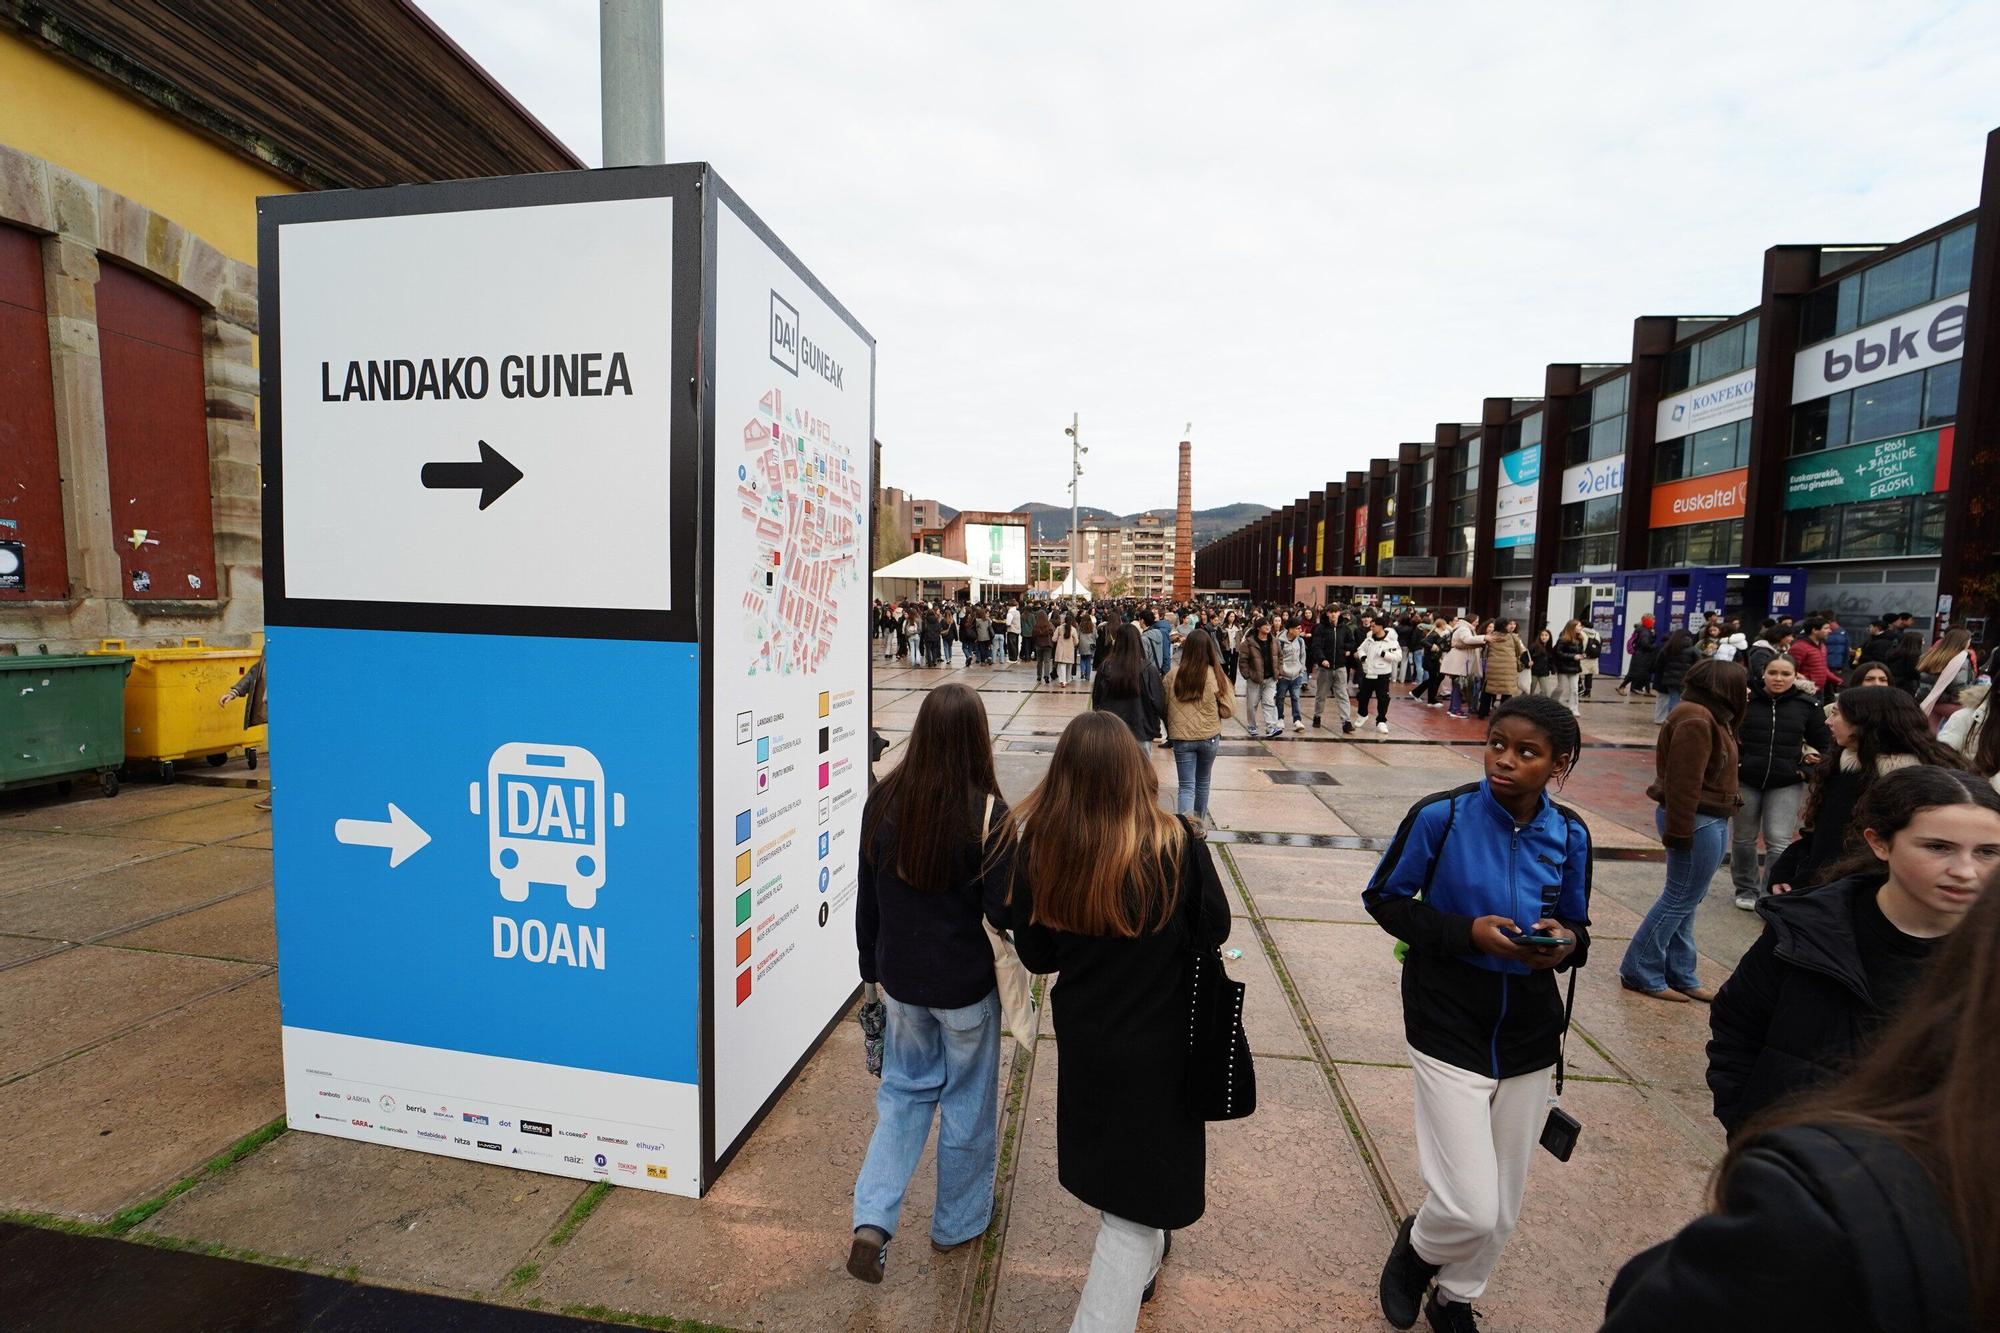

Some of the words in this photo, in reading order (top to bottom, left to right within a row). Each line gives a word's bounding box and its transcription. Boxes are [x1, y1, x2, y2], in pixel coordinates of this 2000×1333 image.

[774, 313, 796, 355] DA!
[801, 336, 844, 391] GUNEAK
[1823, 326, 1920, 383] bbk
[321, 355, 489, 402] LANDAKO
[500, 352, 633, 398] GUNEA
[1868, 447, 1917, 471] BAZKIDE
[1875, 438, 1906, 457] EROSI
[1876, 462, 1902, 478] TOKI
[1870, 474, 1914, 498] EROSKI
[1673, 487, 1736, 513] euskaltel
[507, 781, 586, 839] DA!
[493, 916, 605, 970] DOAN
[406, 1104, 427, 1114] berria
[352, 1119, 368, 1128] GARA
[454, 1136, 471, 1146] hitza
[636, 1142, 661, 1151] elhuyar
[564, 1155, 584, 1164] naiz:
